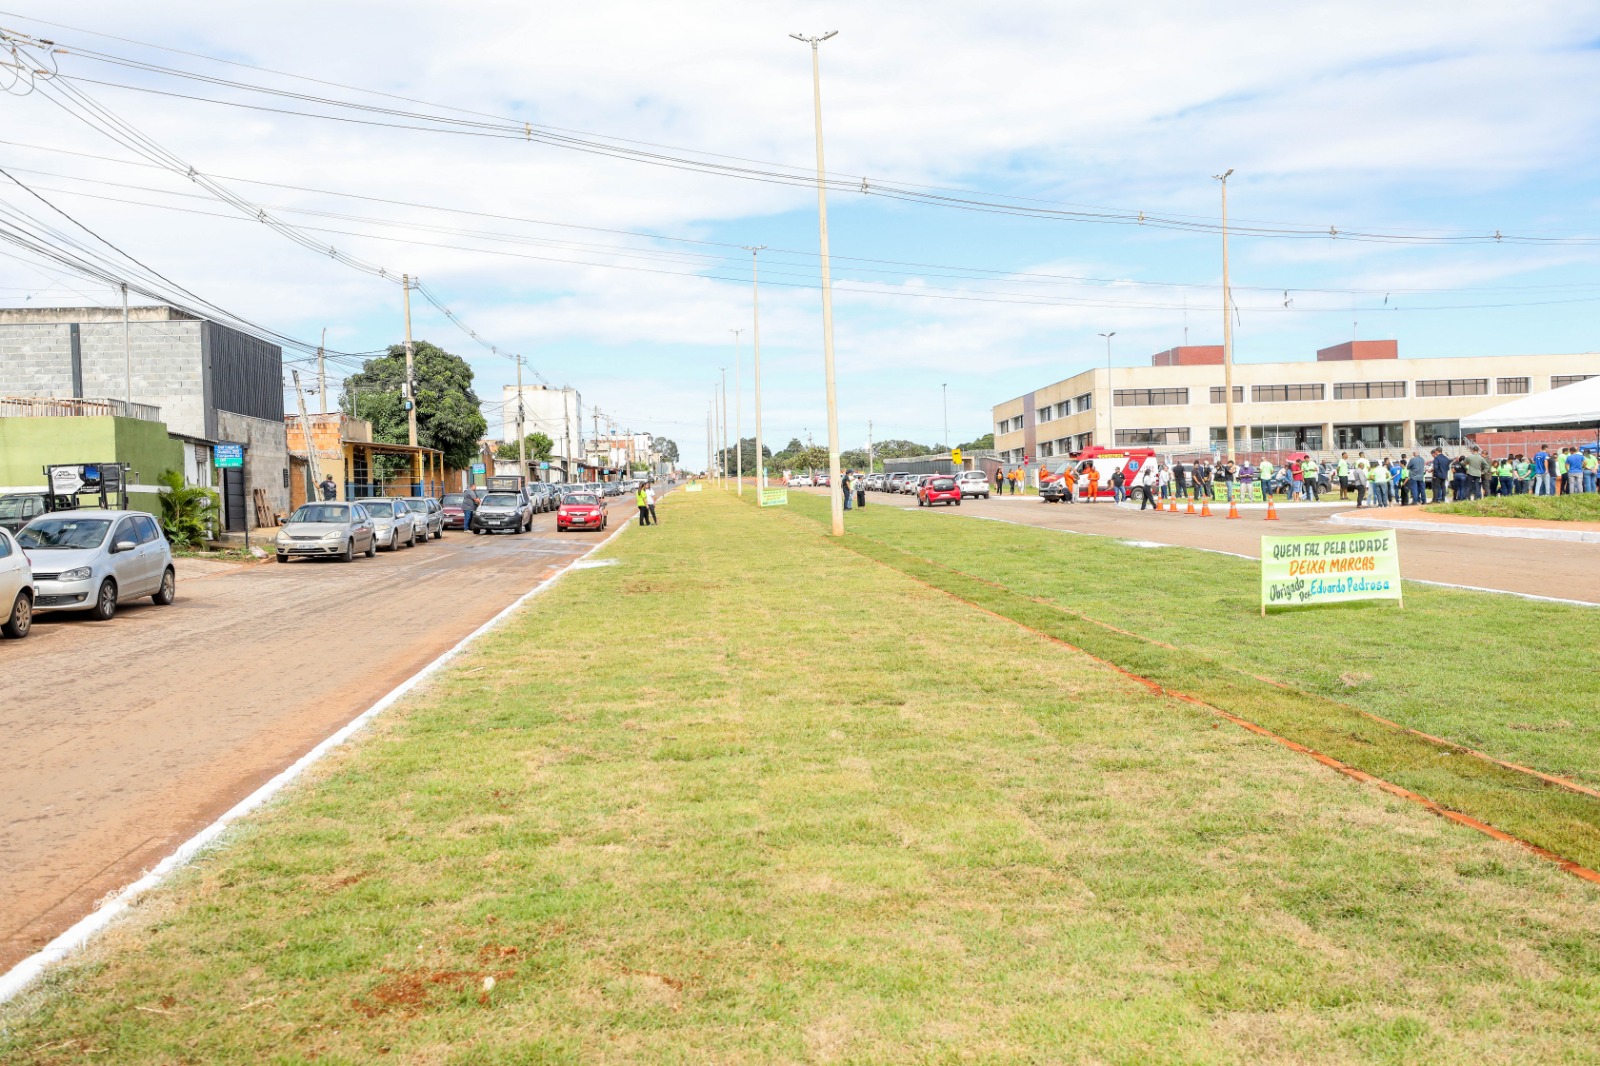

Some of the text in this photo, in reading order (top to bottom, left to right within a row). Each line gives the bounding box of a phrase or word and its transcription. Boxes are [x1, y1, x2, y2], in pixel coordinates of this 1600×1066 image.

[1273, 538, 1389, 559] QUEM FAZ PELA CIDADE
[1289, 556, 1375, 576] DEIXA MARCAS
[1270, 577, 1305, 601] Obrigado
[1310, 579, 1346, 595] Eduardo
[1347, 577, 1389, 592] Pedrosa
